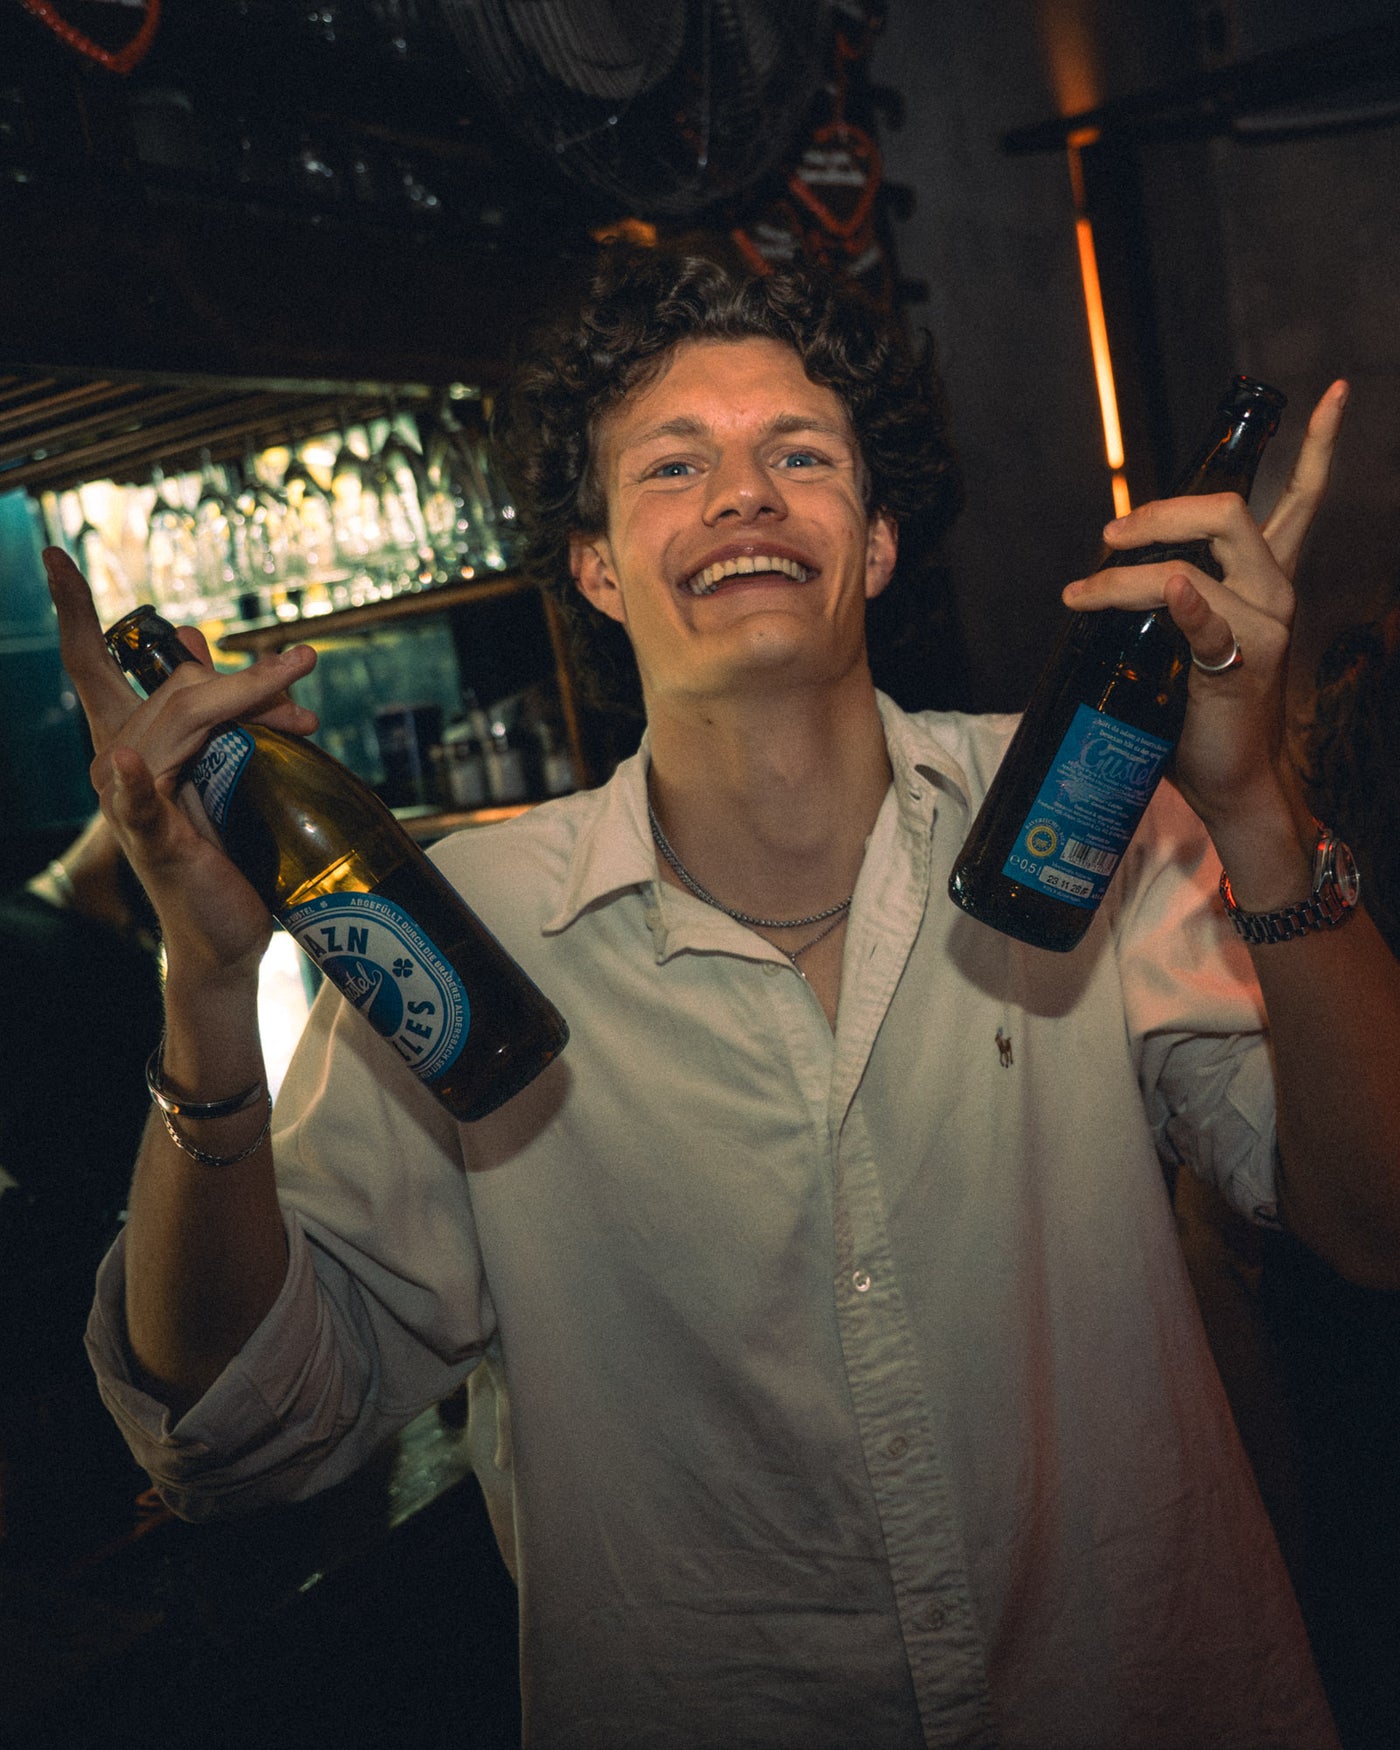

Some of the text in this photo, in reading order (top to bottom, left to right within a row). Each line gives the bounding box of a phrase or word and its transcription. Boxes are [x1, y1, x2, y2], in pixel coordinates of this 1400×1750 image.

[1019, 858, 1037, 874] 0,5
[350, 898, 403, 922] ABGEFÜLLT
[401, 922, 424, 949] DURCH
[423, 947, 437, 962] DIE
[434, 960, 461, 1003] BRAUEREI
[442, 1004, 463, 1060] ALDERSBACH
